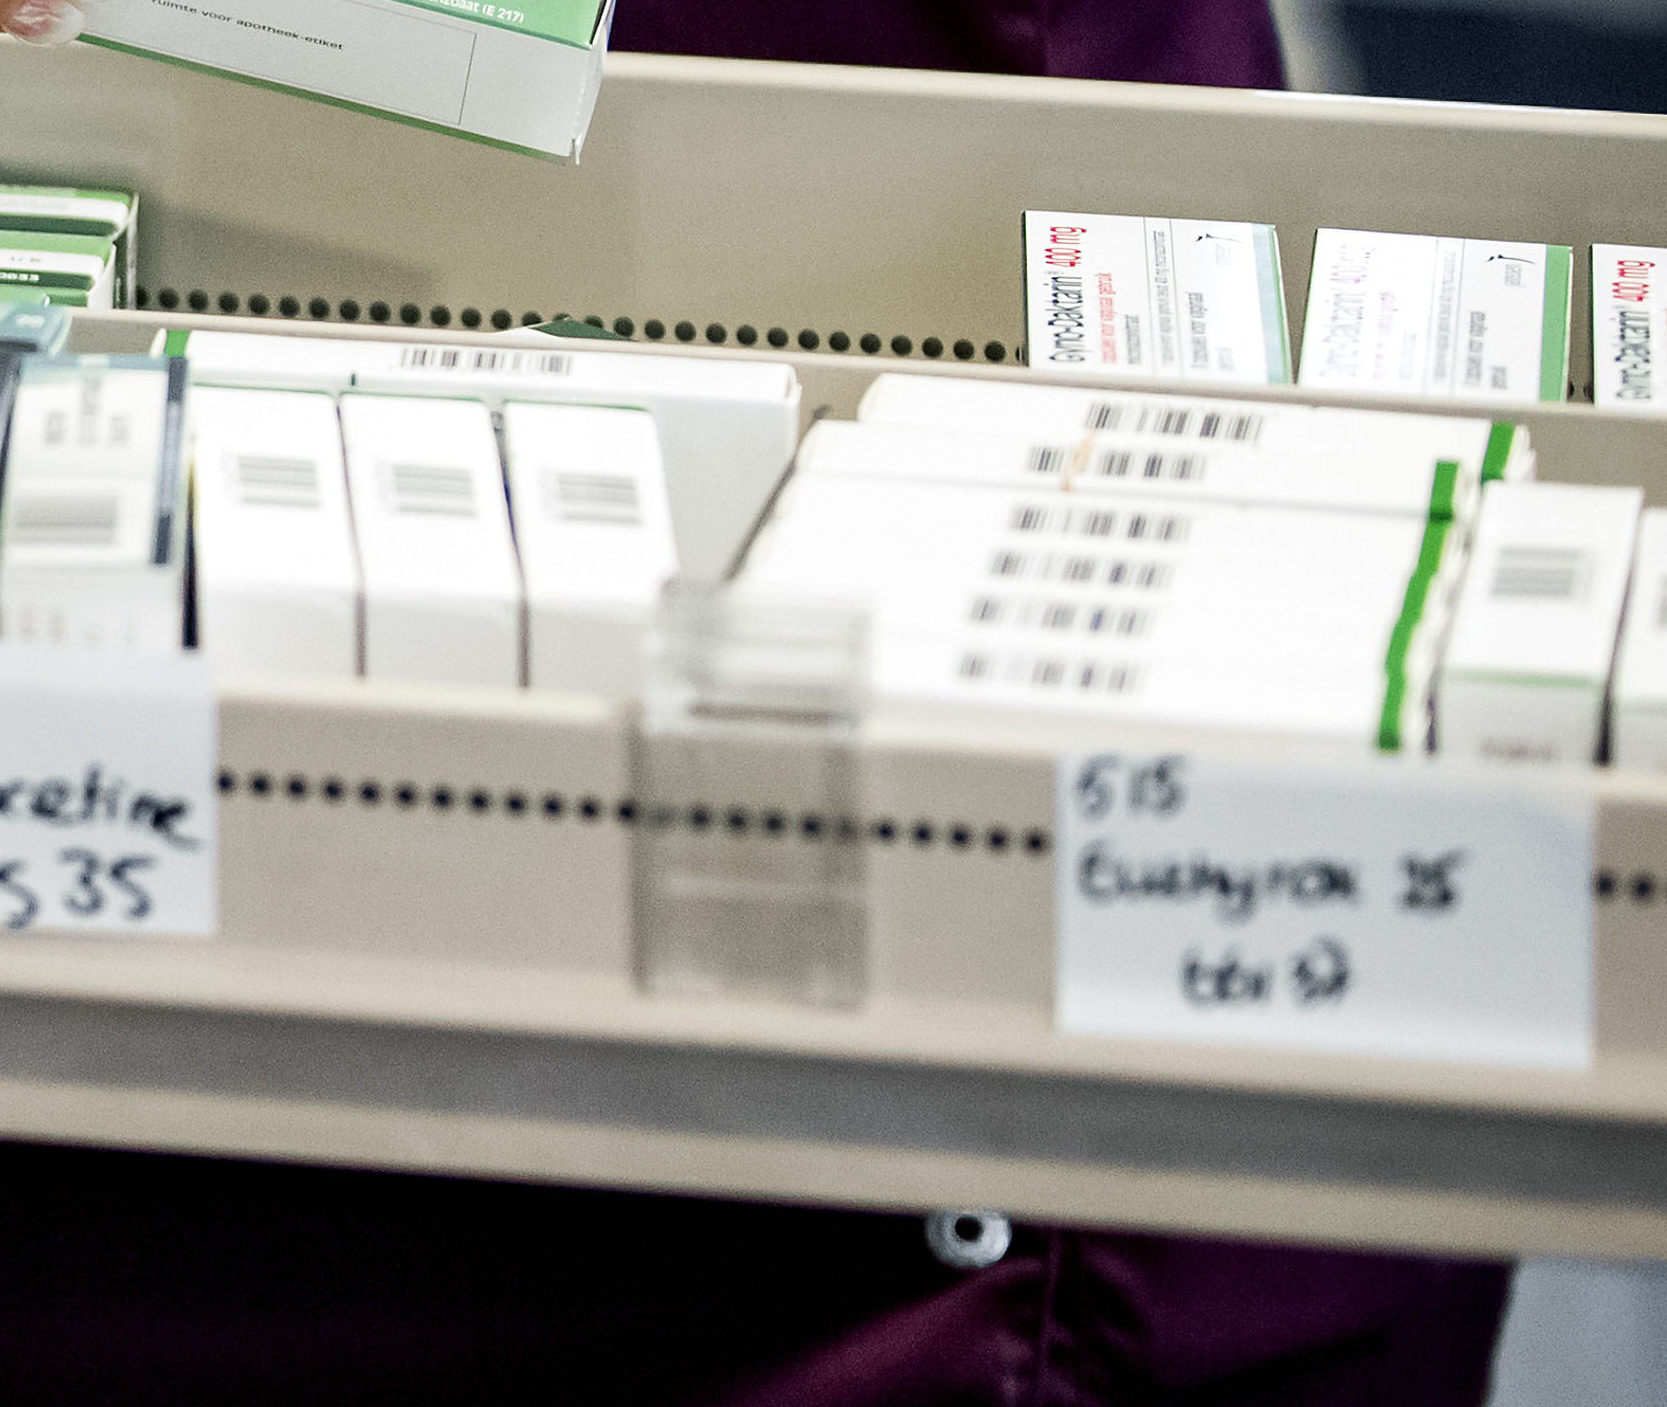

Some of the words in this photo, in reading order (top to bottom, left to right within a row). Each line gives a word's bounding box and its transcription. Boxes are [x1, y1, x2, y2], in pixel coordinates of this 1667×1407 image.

[497, 7, 524, 24] 217)
[201, 9, 232, 24] voor
[236, 18, 344, 51] apotheek-etiket
[1048, 224, 1087, 245] mg
[1044, 246, 1082, 268] 400
[1616, 258, 1655, 279] mg
[1611, 280, 1649, 302] 400
